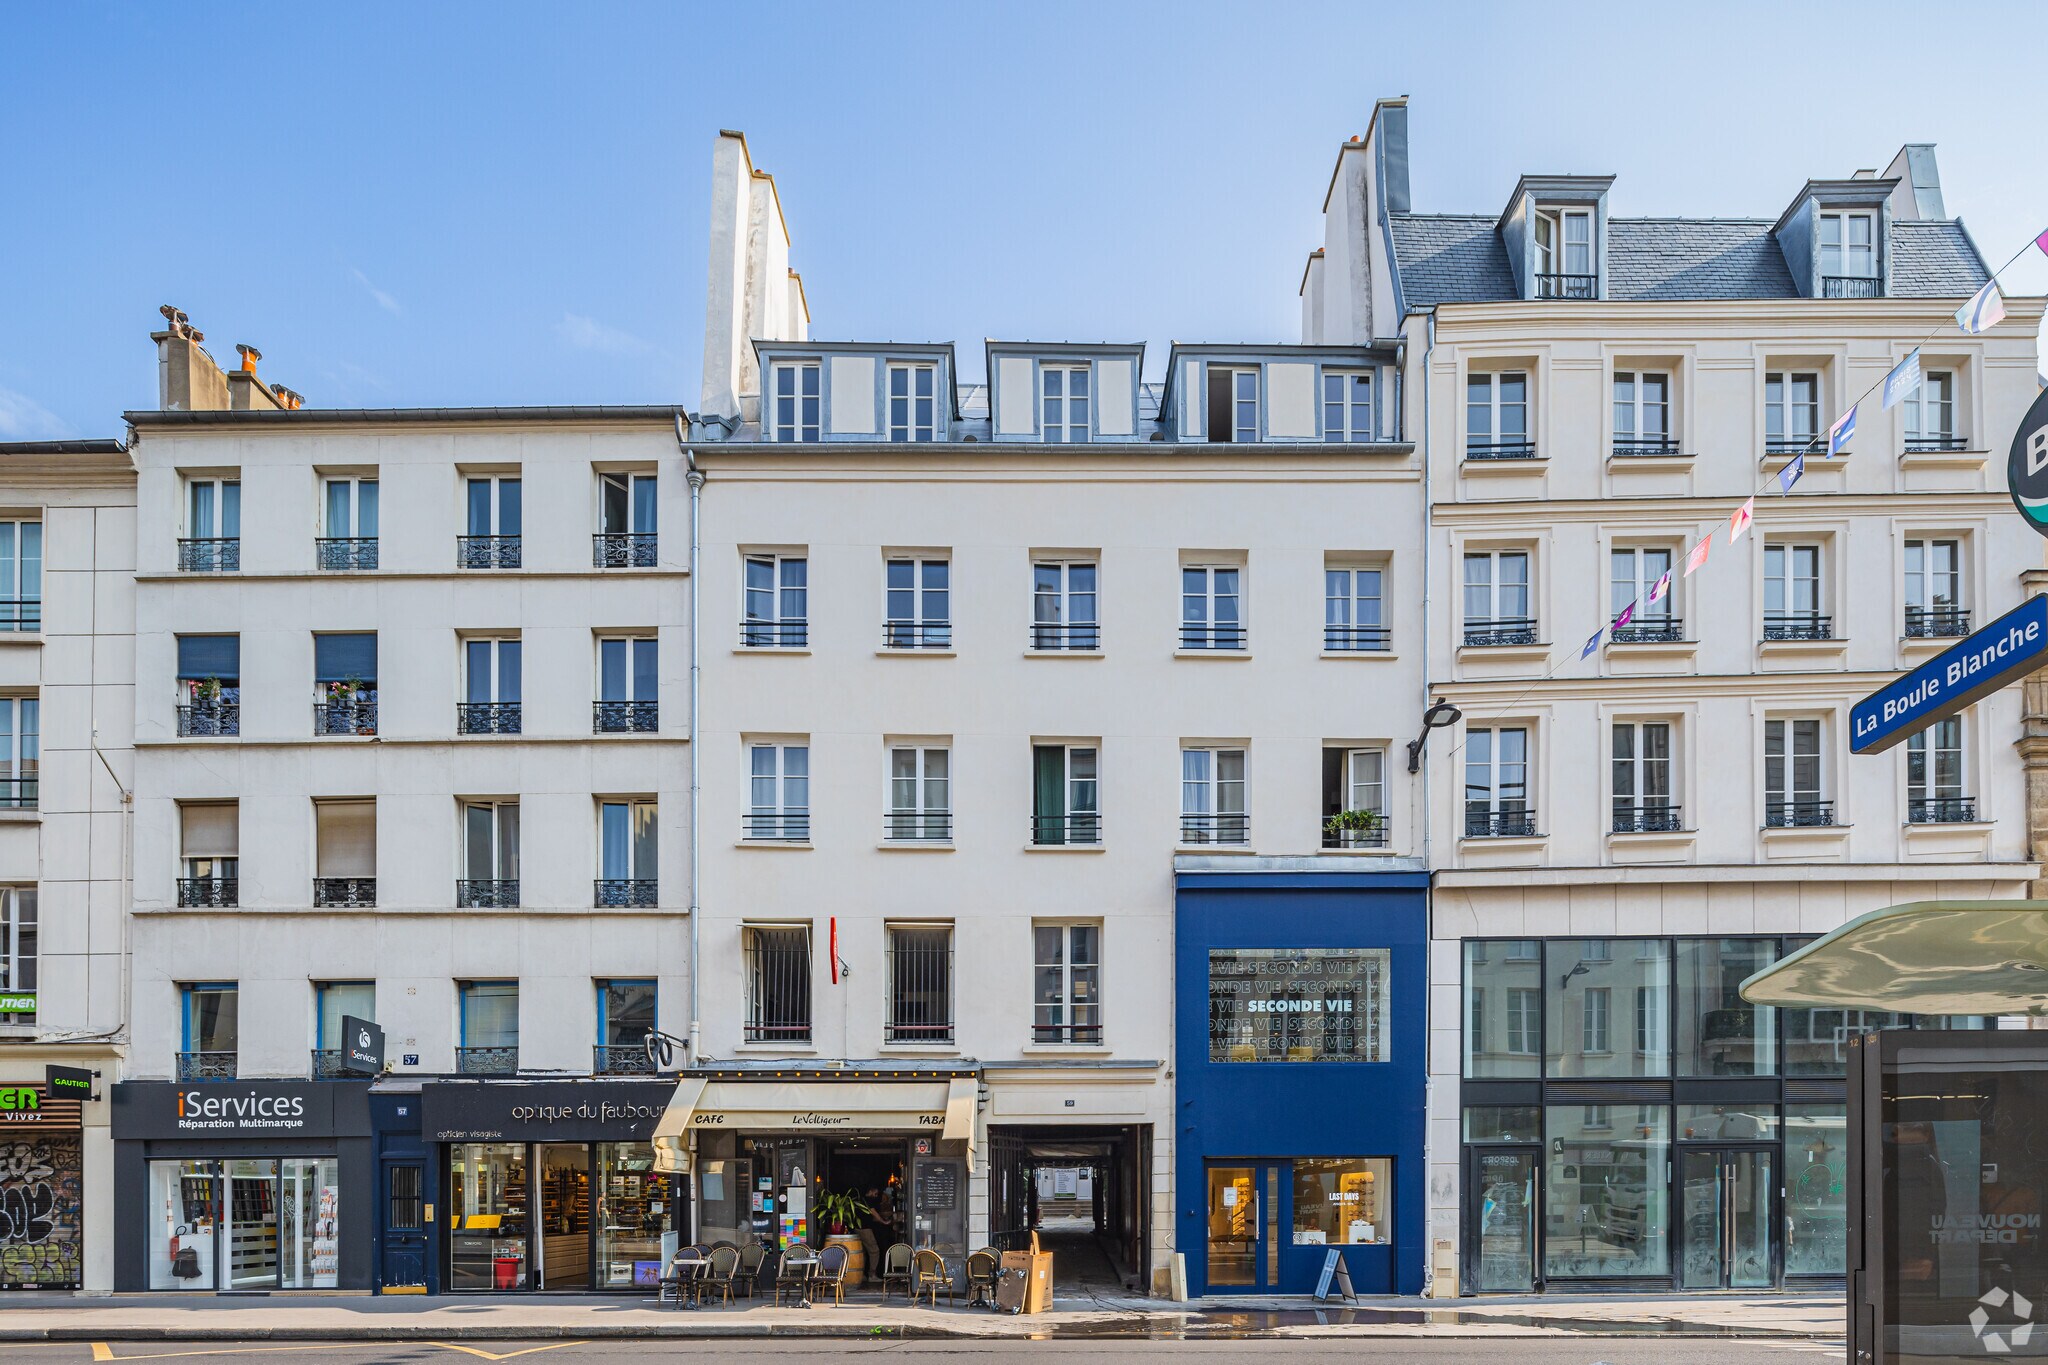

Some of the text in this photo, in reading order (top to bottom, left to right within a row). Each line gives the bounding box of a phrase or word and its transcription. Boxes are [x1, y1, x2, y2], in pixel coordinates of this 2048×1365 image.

[1857, 621, 2039, 738] La Boule Blanche
[1247, 961, 1322, 975] SECONDE
[1326, 961, 1353, 974] VIE
[1254, 981, 1281, 994] VIE
[1287, 980, 1362, 994] SECONDE
[1216, 1000, 1243, 1013] VIE
[1247, 1000, 1322, 1012] SECONDE
[1325, 1000, 1352, 1012] VIE
[1254, 1018, 1282, 1031] VIE
[1288, 1017, 1362, 1031] SECONDE
[1248, 1036, 1322, 1050] SECONDE
[1326, 1036, 1353, 1049] VIE
[1850, 1039, 1859, 1047] 12
[351, 1048, 377, 1064] iServices
[405, 1056, 417, 1064] 57
[54, 1078, 89, 1089] GAUTIER
[178, 1091, 304, 1117] iServices
[6, 1112, 42, 1121] Vivez
[512, 1103, 573, 1124] optique
[577, 1100, 597, 1118] du
[178, 1119, 304, 1130] Réparation Multimarque
[695, 1114, 724, 1124] CAFE
[792, 1115, 802, 1124] Le
[437, 1129, 502, 1140] opticien visagiste
[1328, 1193, 1360, 1201] LAST DAYS
